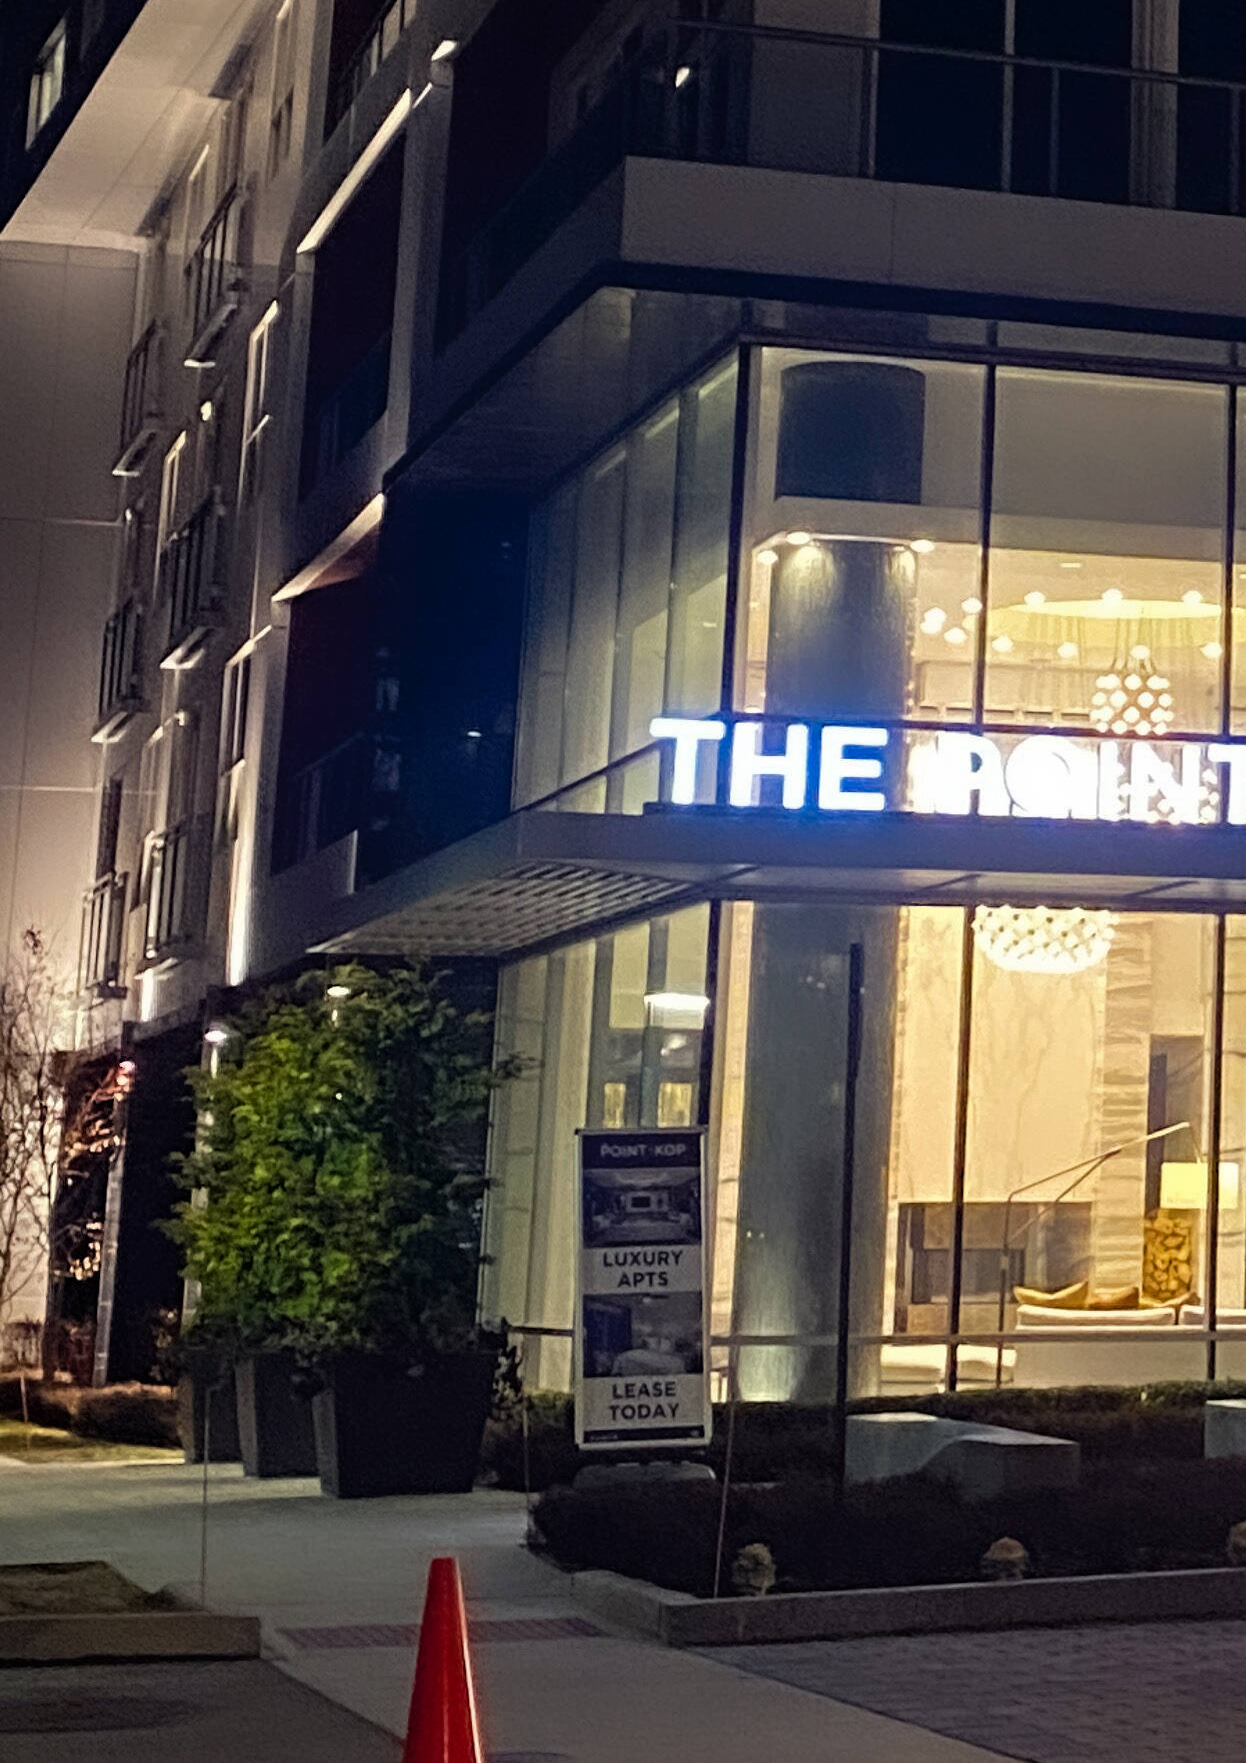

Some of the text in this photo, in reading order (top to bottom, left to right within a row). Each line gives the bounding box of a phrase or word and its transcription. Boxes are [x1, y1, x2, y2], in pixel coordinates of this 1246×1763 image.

[649, 718, 887, 811] THE
[601, 1143, 686, 1157] POINT KOP
[603, 1251, 682, 1267] LUXURY
[618, 1272, 668, 1287] APTS
[612, 1383, 676, 1399] LEASE
[609, 1404, 679, 1420] TODAY
